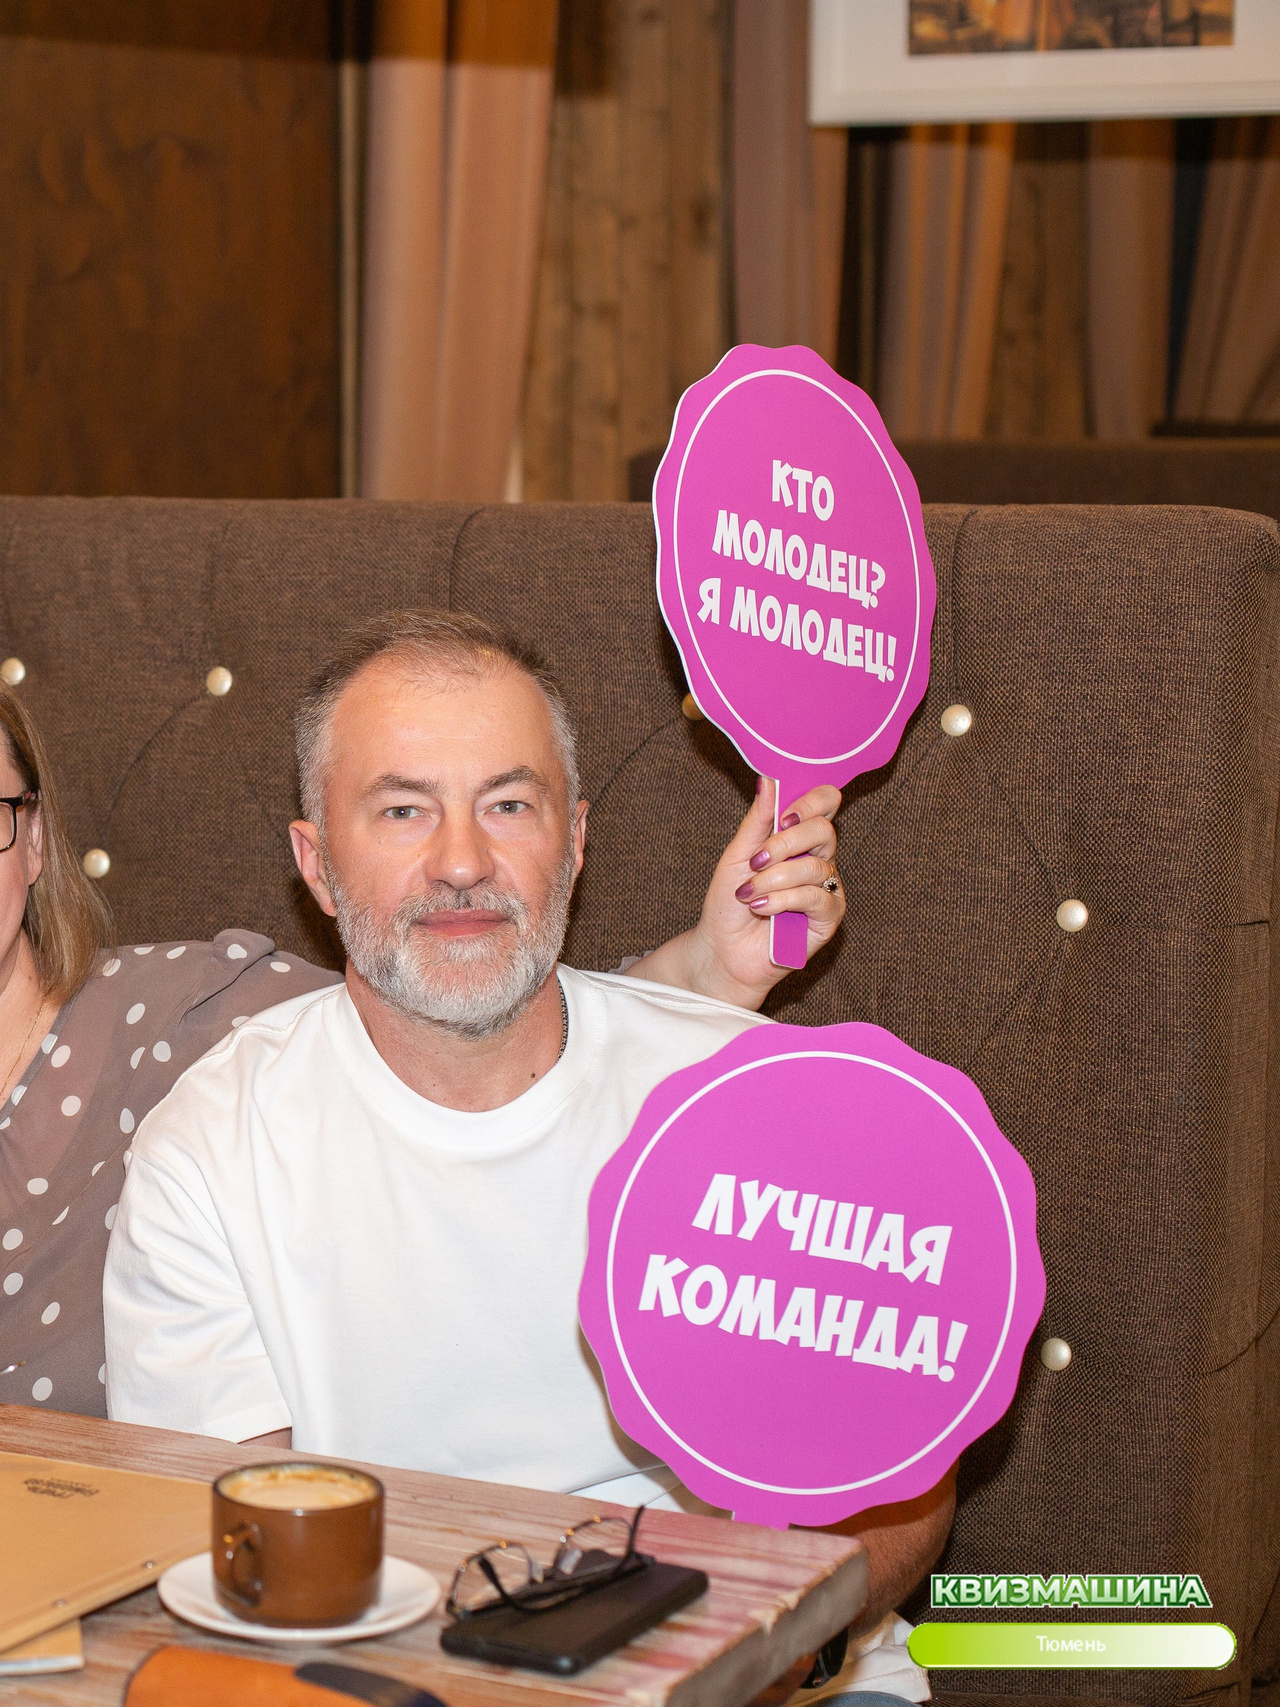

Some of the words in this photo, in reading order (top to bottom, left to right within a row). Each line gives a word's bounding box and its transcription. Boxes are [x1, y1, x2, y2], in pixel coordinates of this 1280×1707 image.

[771, 460, 835, 521] КТО
[712, 509, 886, 609] МОЛОДЕЦ?
[696, 577, 721, 624] Я
[729, 586, 897, 683] МОЛОДЕЦ!
[691, 1173, 953, 1286] ЛУЧШАЯ
[638, 1254, 969, 1383] КОМАНДА!
